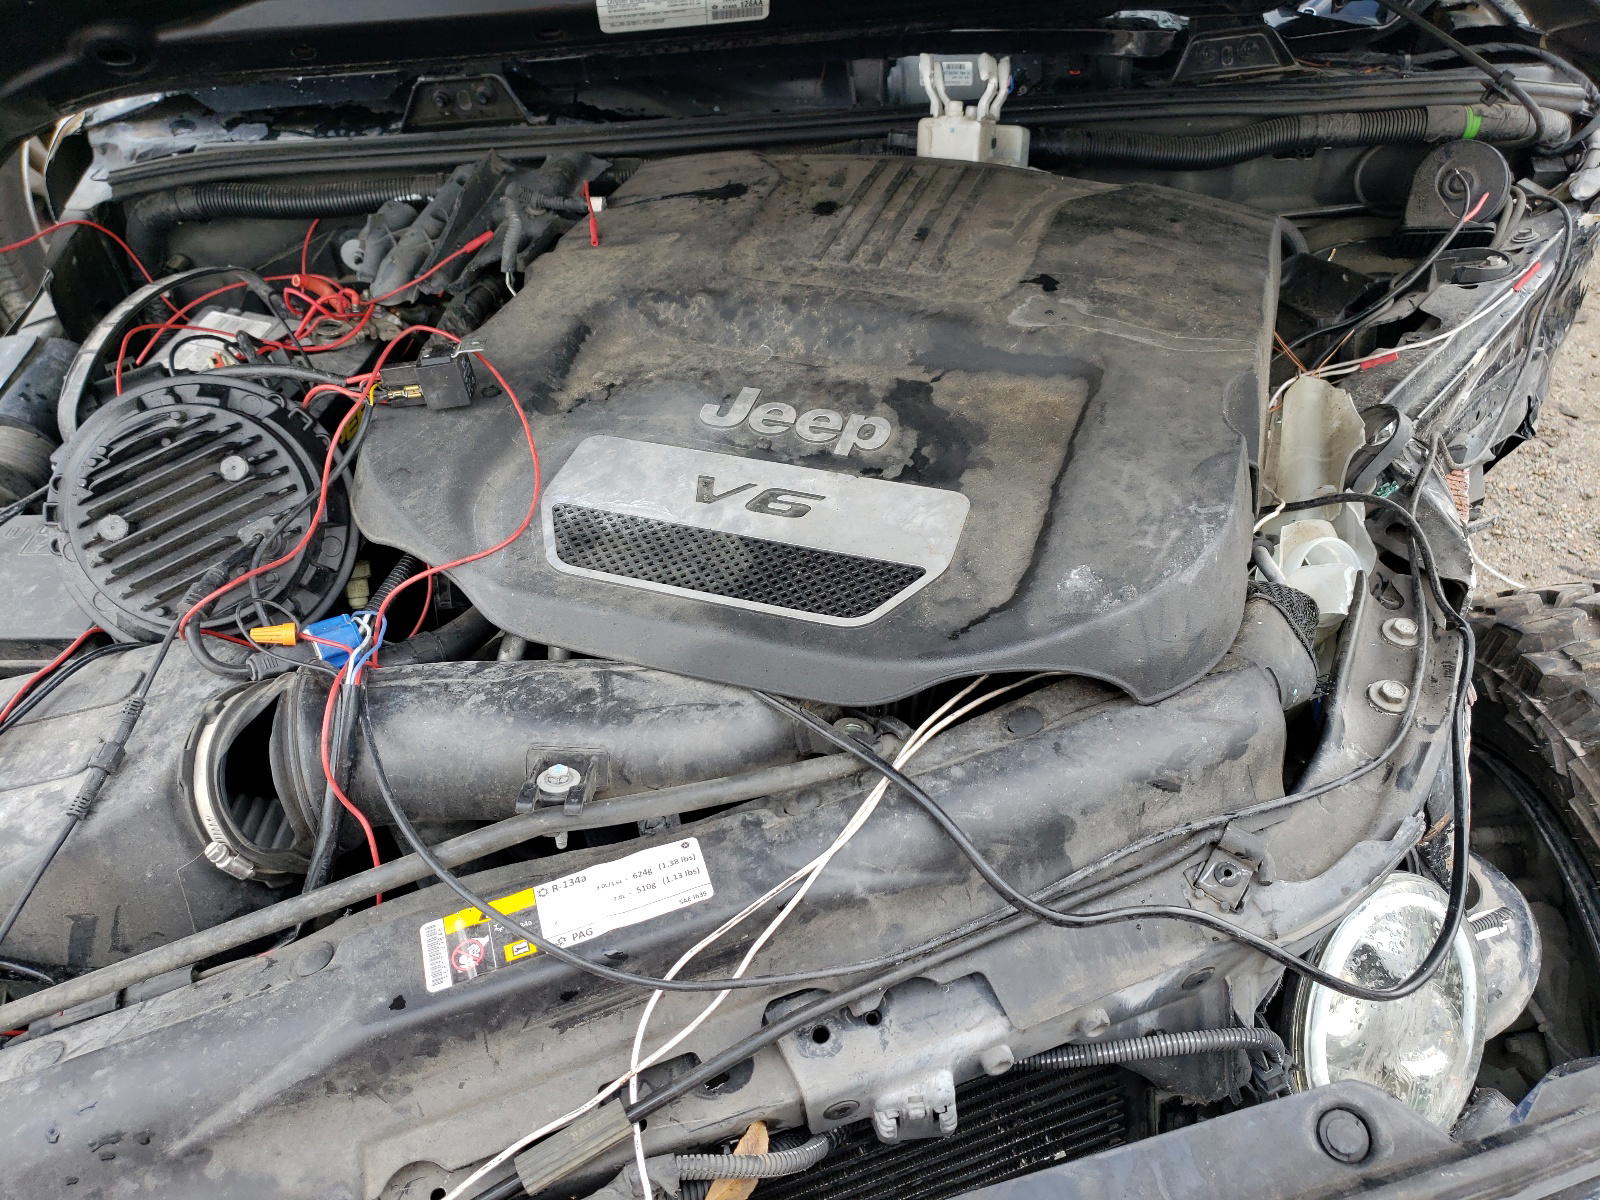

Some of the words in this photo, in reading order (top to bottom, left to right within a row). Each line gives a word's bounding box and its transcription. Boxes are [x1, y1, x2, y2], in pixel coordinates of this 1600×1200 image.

[699, 386, 892, 456] Jeep
[695, 474, 826, 518] V6
[551, 875, 587, 893] R-134a
[572, 927, 594, 941] PAG
